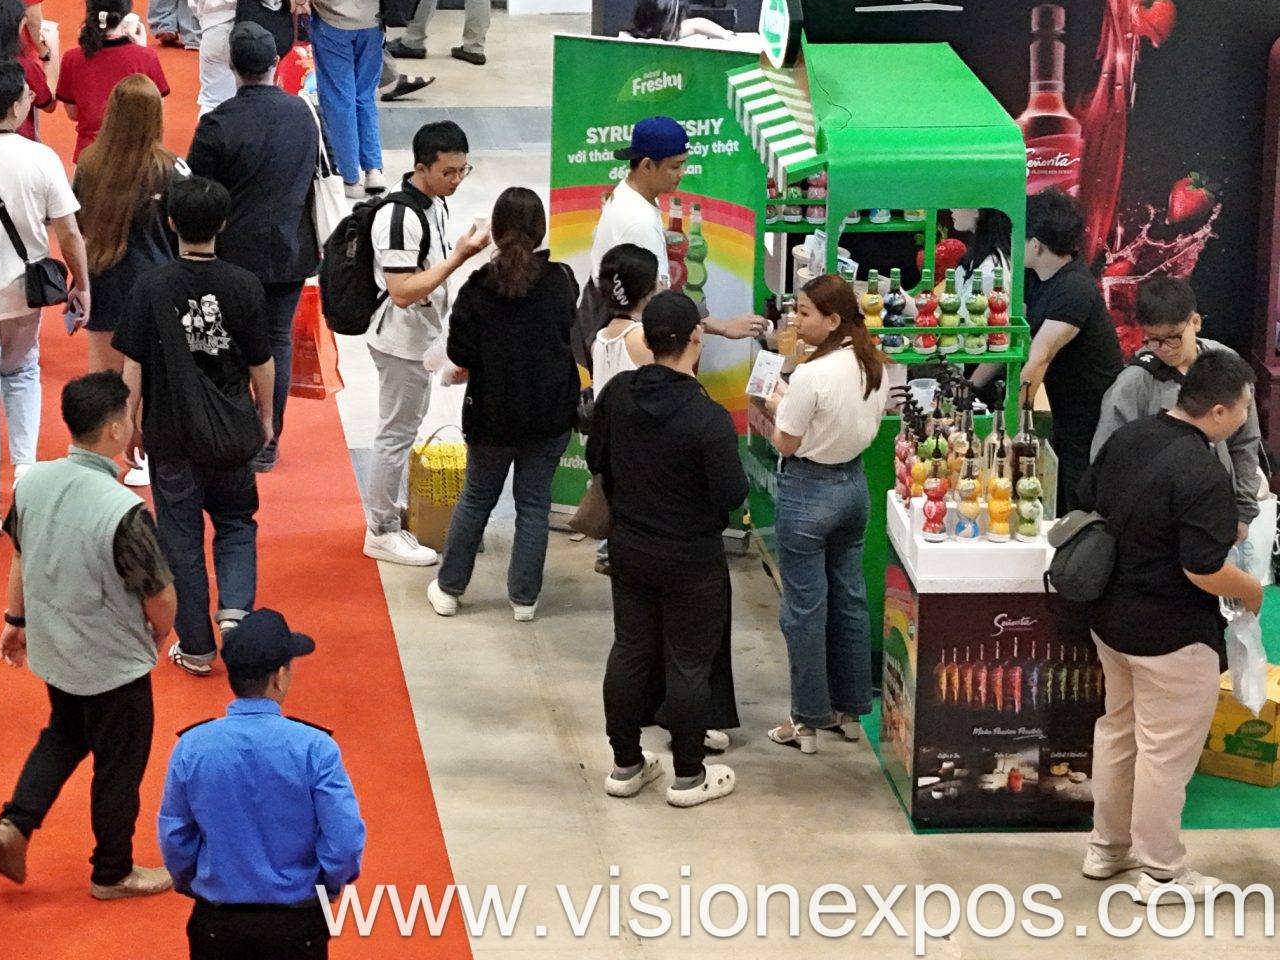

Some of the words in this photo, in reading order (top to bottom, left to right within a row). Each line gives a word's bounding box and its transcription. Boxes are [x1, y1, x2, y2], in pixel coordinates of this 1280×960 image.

[631, 70, 683, 96] Freshy
[586, 124, 635, 145] SYRU
[711, 139, 740, 157] thật
